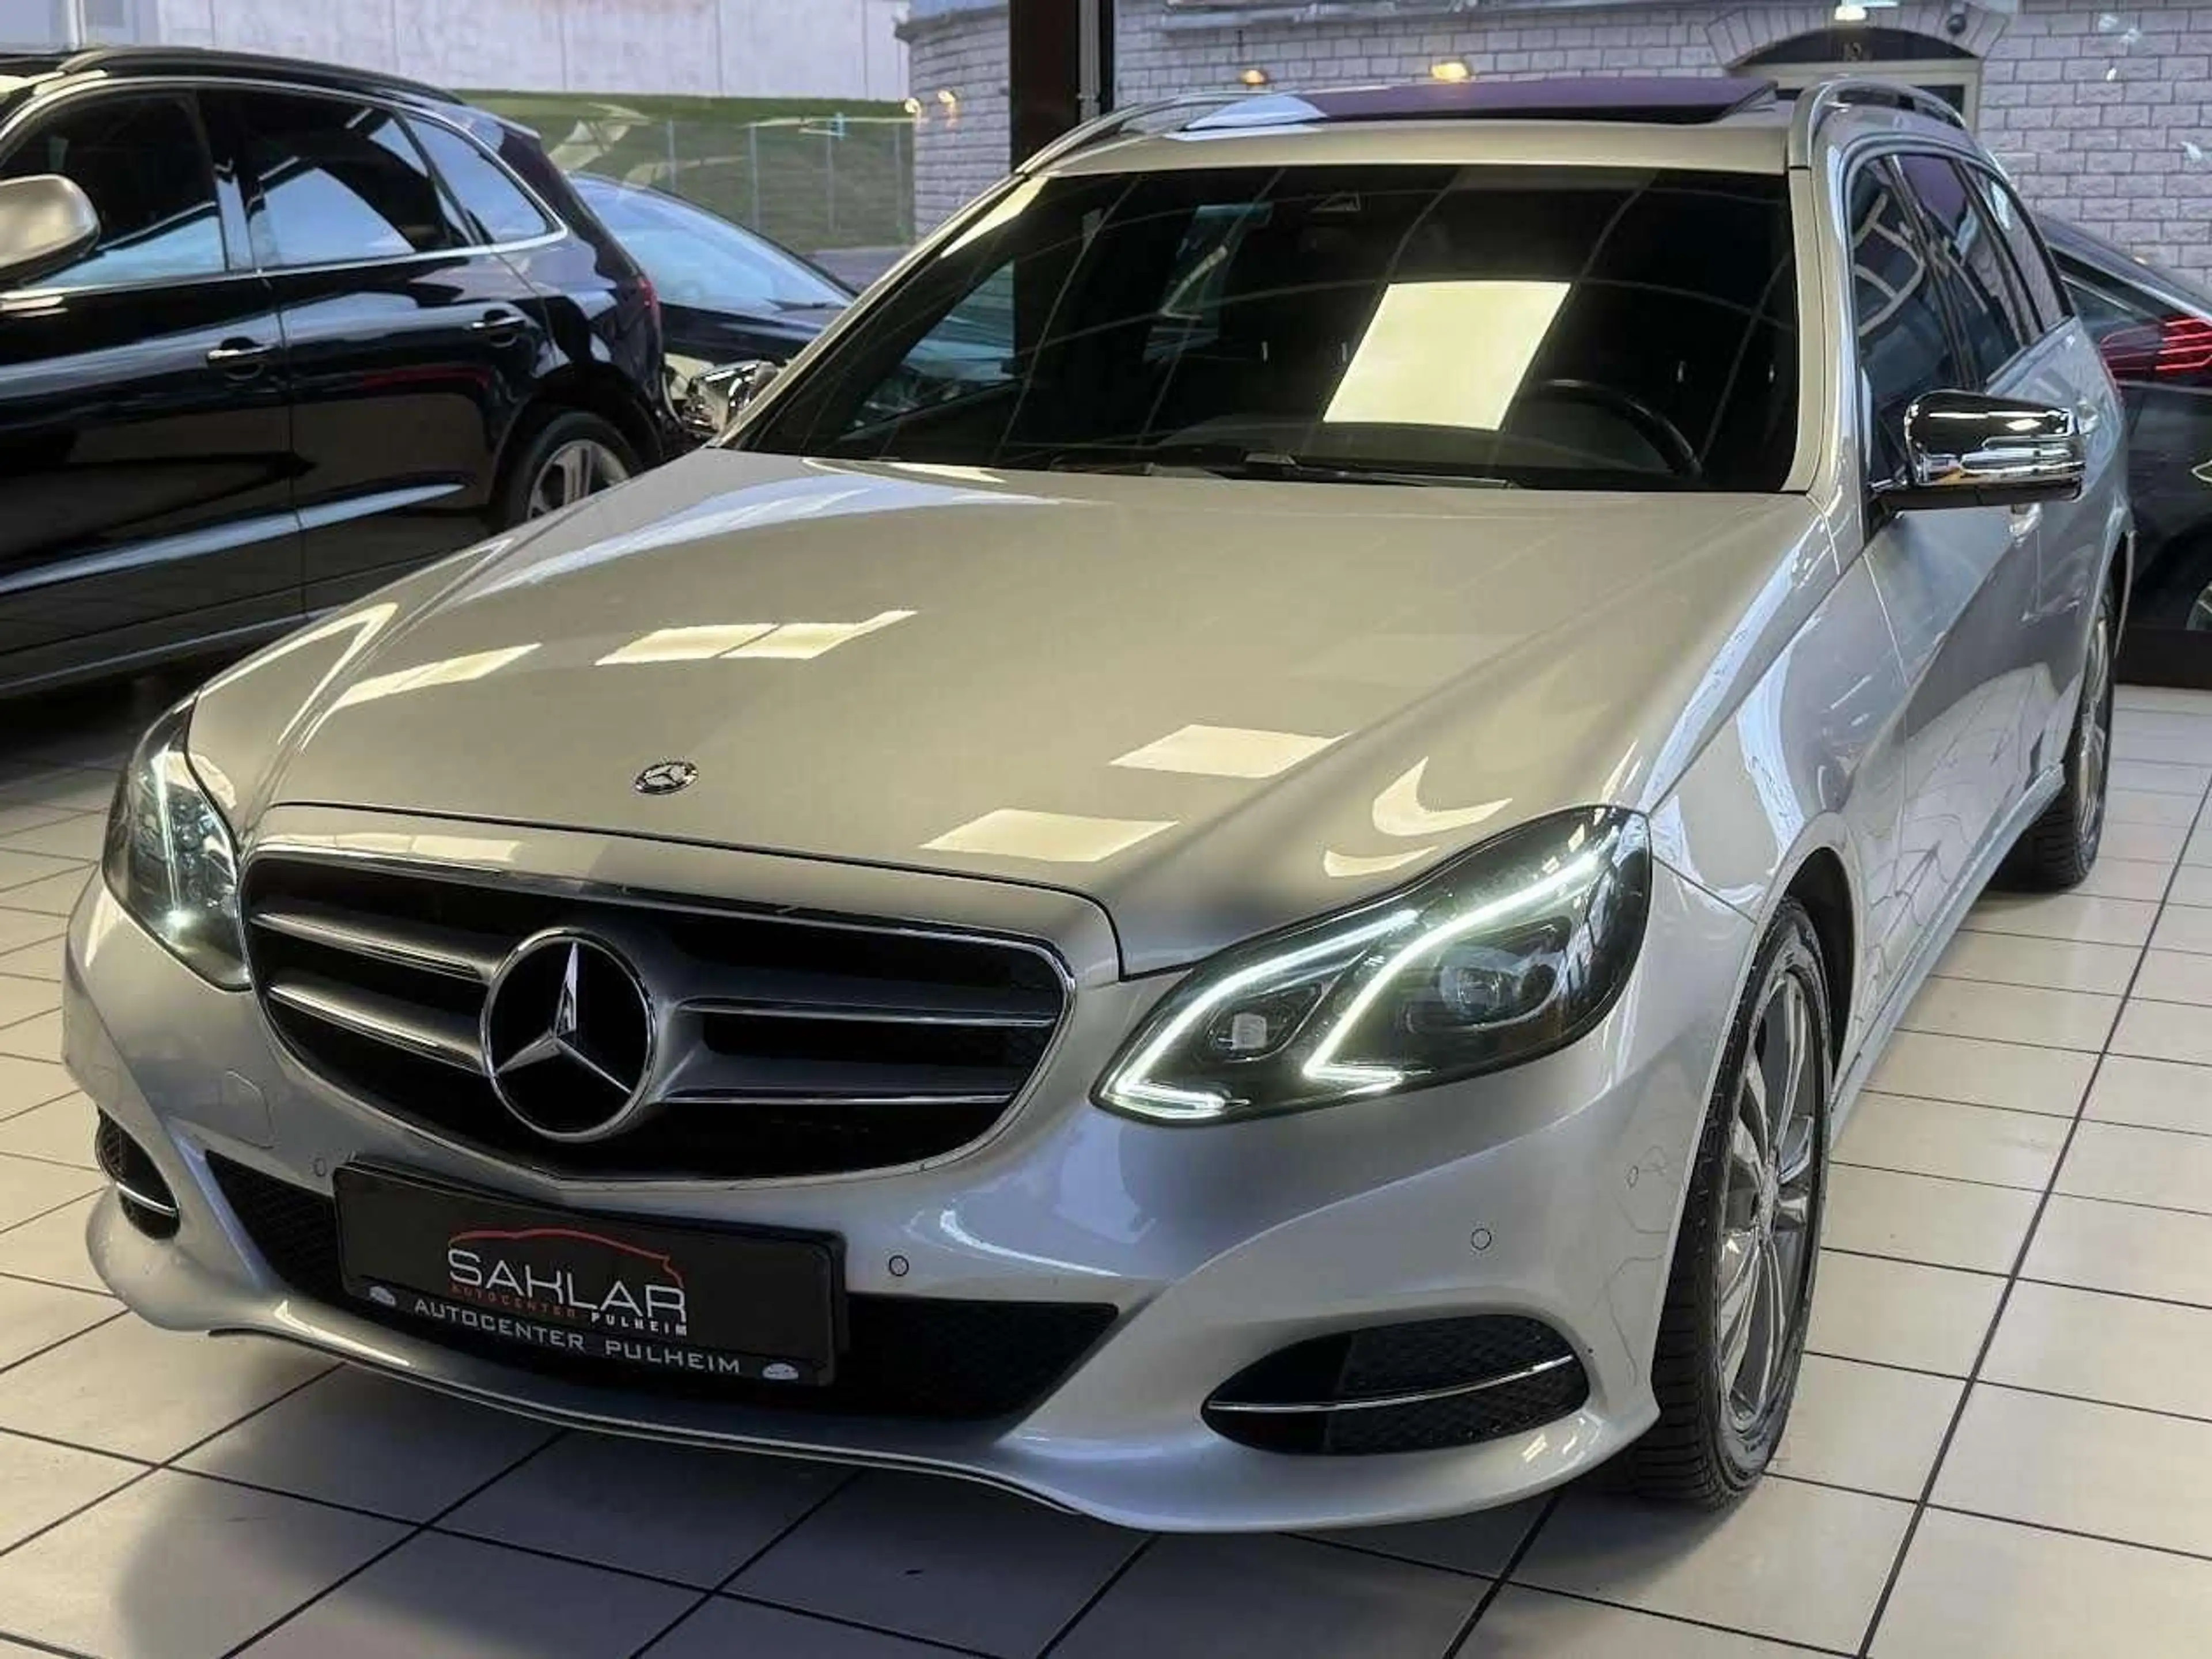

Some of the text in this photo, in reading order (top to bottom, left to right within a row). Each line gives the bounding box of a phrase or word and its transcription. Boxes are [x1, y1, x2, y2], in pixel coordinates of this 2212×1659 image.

[448, 1248, 687, 1323] SAHLAR
[450, 1282, 687, 1337] AUTOCENTER PULHEIM
[414, 1298, 740, 1374] AUTOCENTER PULHEIM
